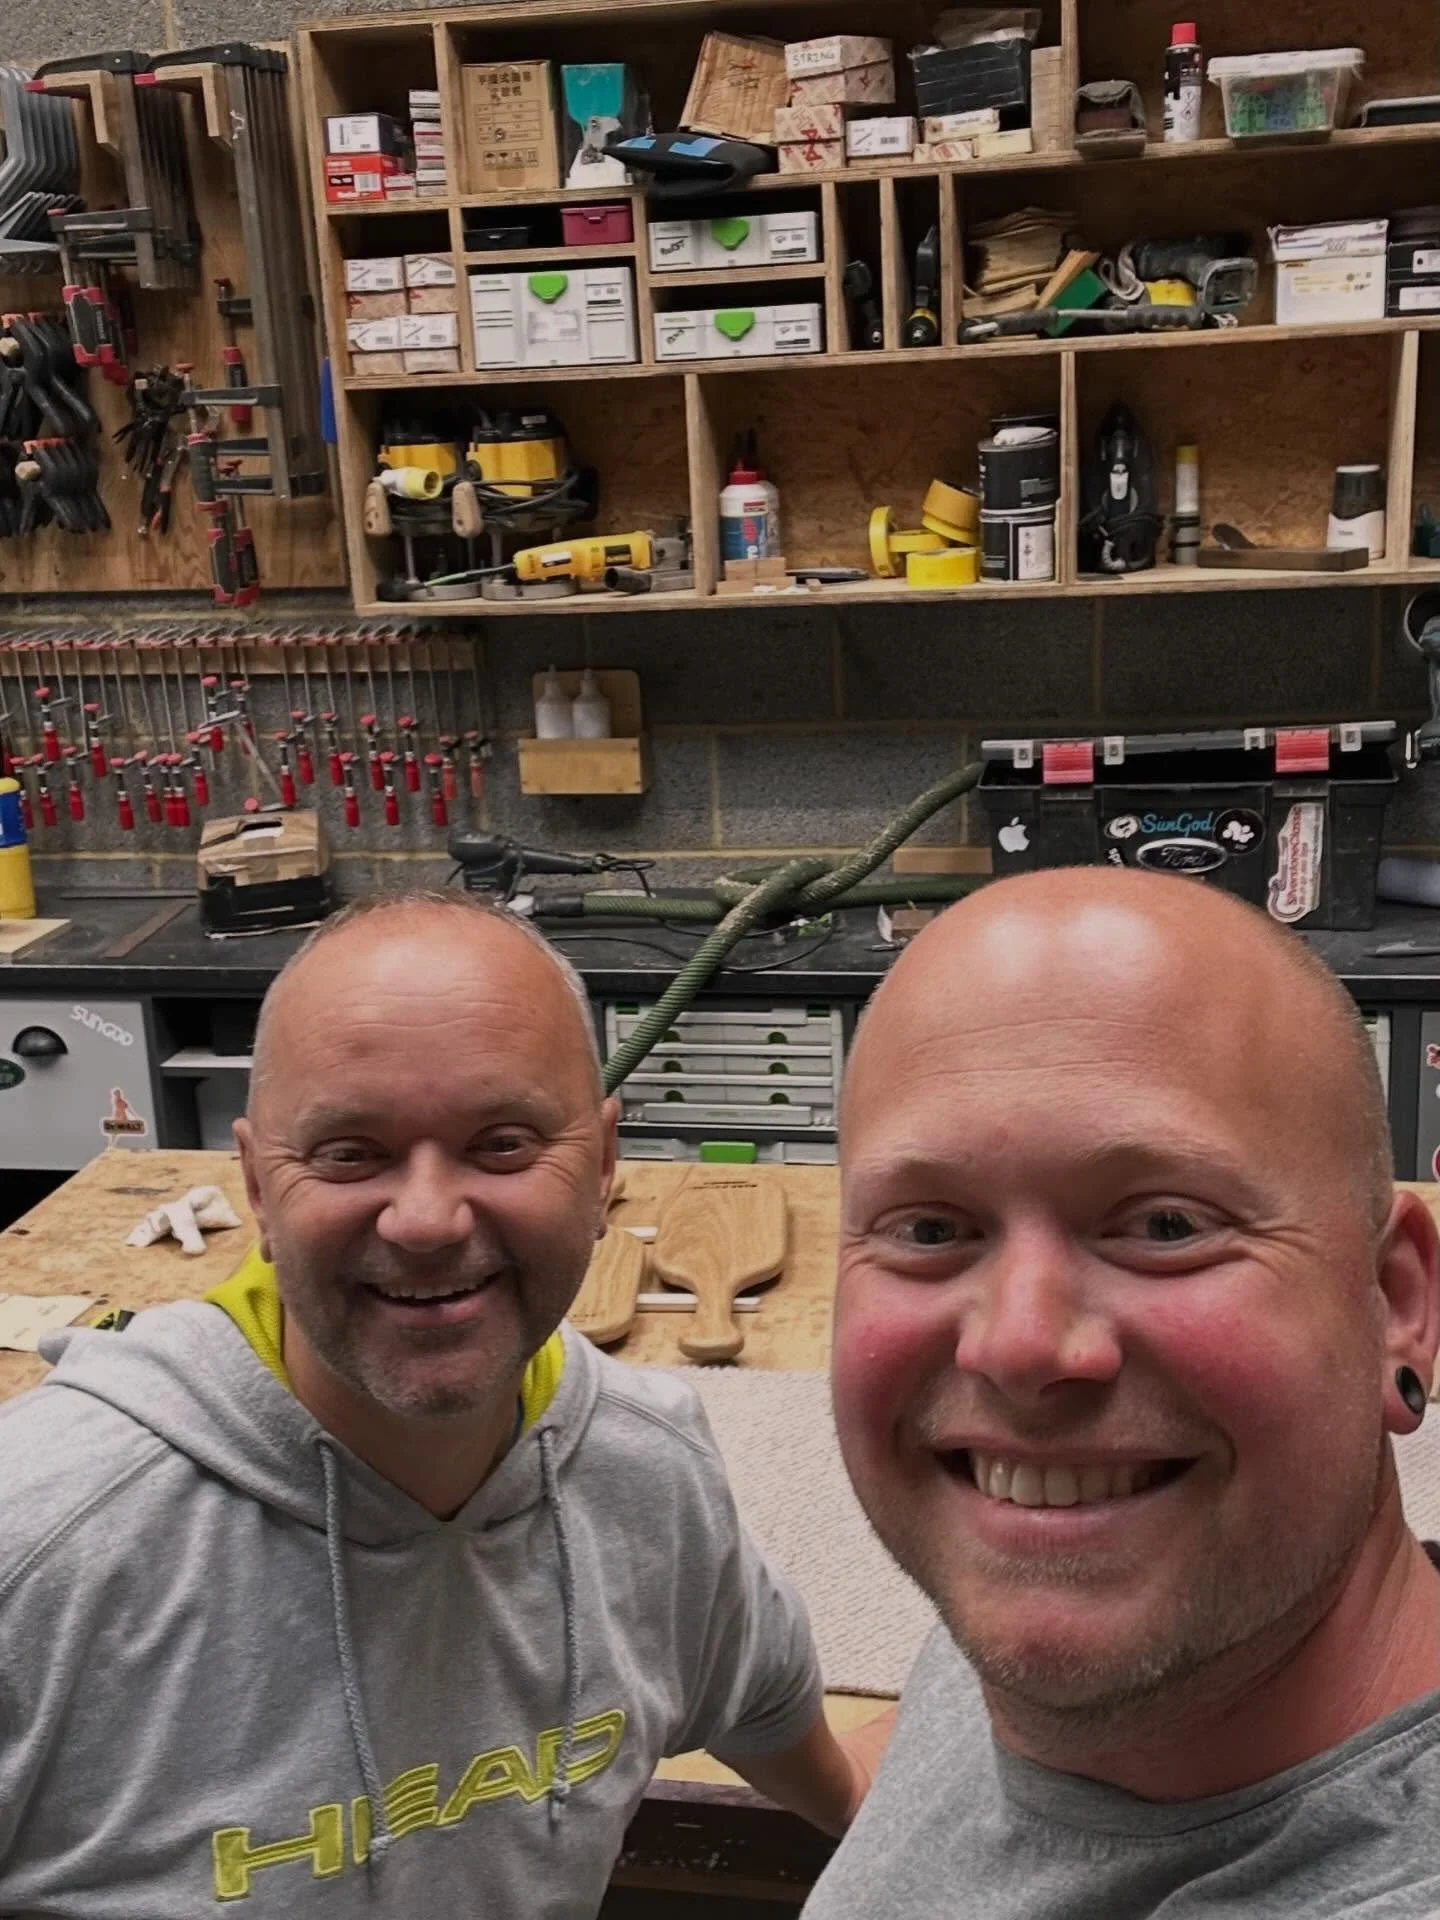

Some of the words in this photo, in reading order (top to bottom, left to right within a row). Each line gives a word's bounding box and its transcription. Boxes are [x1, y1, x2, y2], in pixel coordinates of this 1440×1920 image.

[1141, 811, 1214, 837] SunGod
[1161, 847, 1207, 866] Ford
[212, 1708, 627, 1901] HEAD
